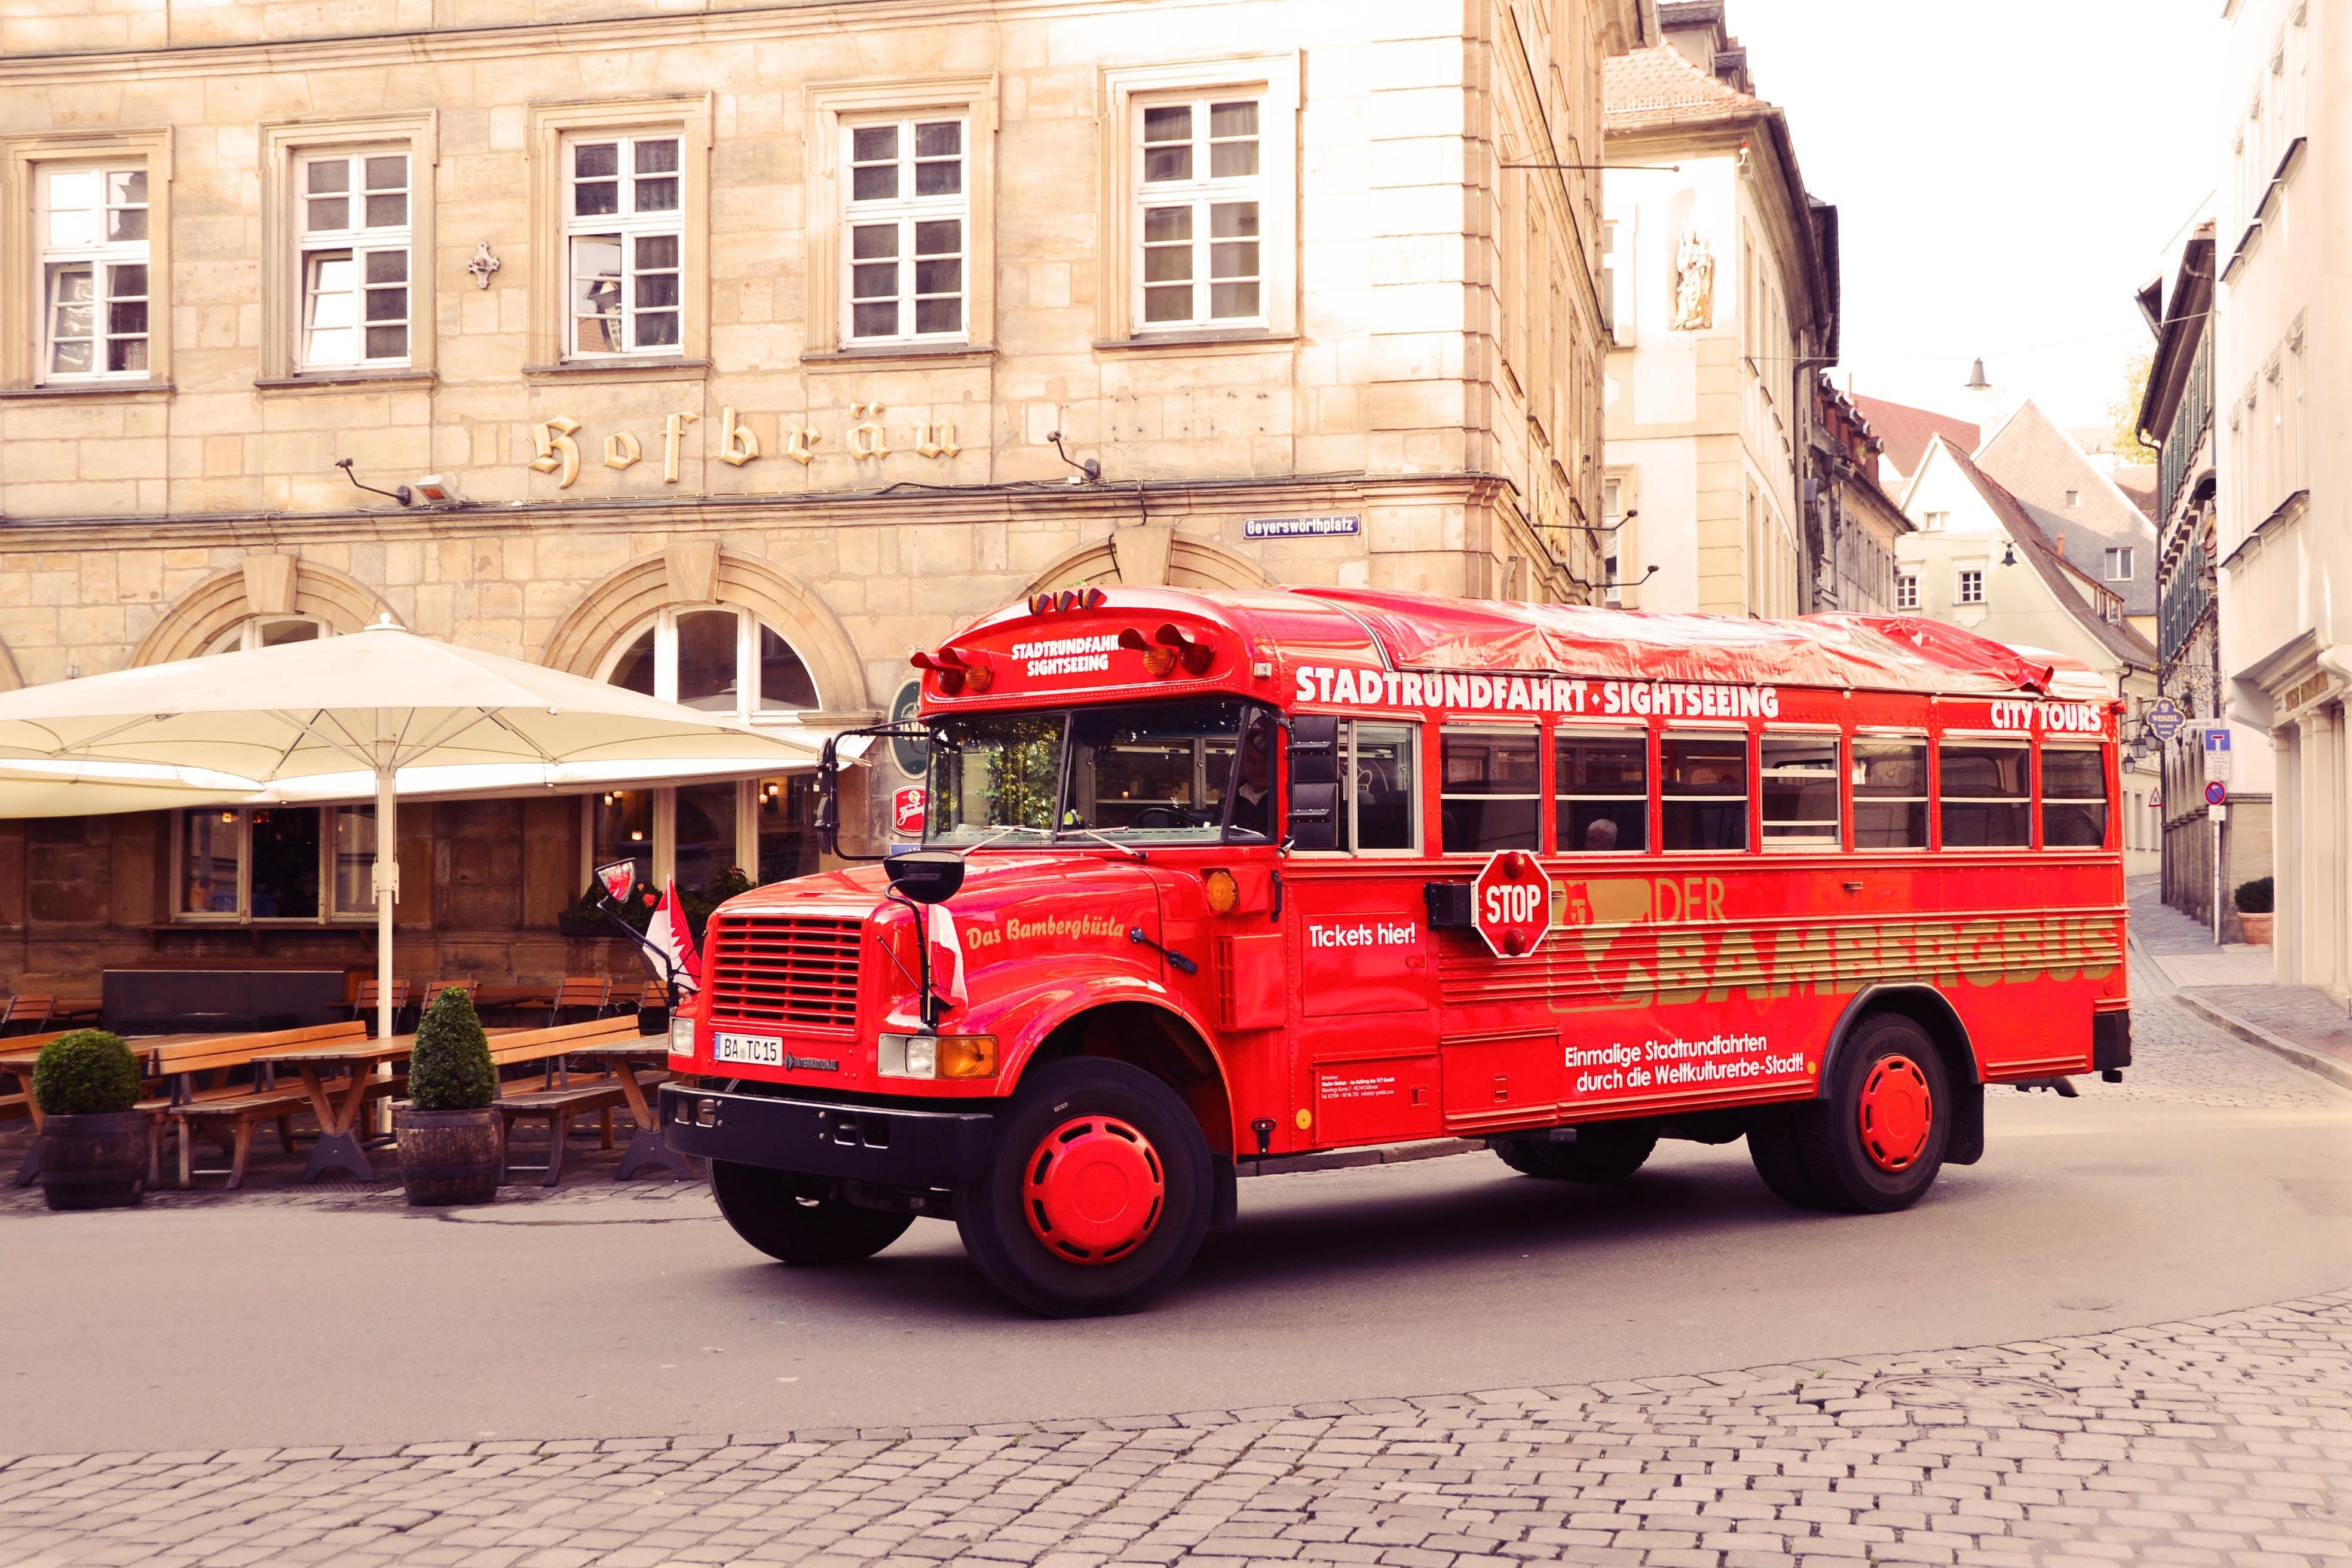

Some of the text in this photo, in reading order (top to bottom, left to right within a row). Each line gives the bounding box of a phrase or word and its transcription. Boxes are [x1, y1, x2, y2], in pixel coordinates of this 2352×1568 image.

[527, 400, 961, 488] Hofbräu
[1247, 517, 1353, 536] Geyerswörthplatz
[1011, 635, 1125, 660] STADTRUNDFAHR
[1027, 654, 1108, 677] SIGHTSEEING
[1296, 666, 1779, 718] STADTRUNDFAHRT SIGHTSEEING
[1990, 701, 2102, 732] CITY TOURS
[1486, 884, 1541, 924] STOP
[1655, 877, 1726, 924] DER
[966, 914, 1124, 950] Das Bambergbüsla
[1309, 921, 1416, 947] Tickets hier!
[1656, 917, 2118, 1006] BAMBERGBUS
[724, 1039, 777, 1061] BA TC 15
[794, 1057, 837, 1071] INTERNATIONAL
[1564, 1033, 1767, 1068] Einmalige Stadtrundfahrten
[1576, 1052, 1804, 1092] durch die Weltkulturerbe-Stadt!
